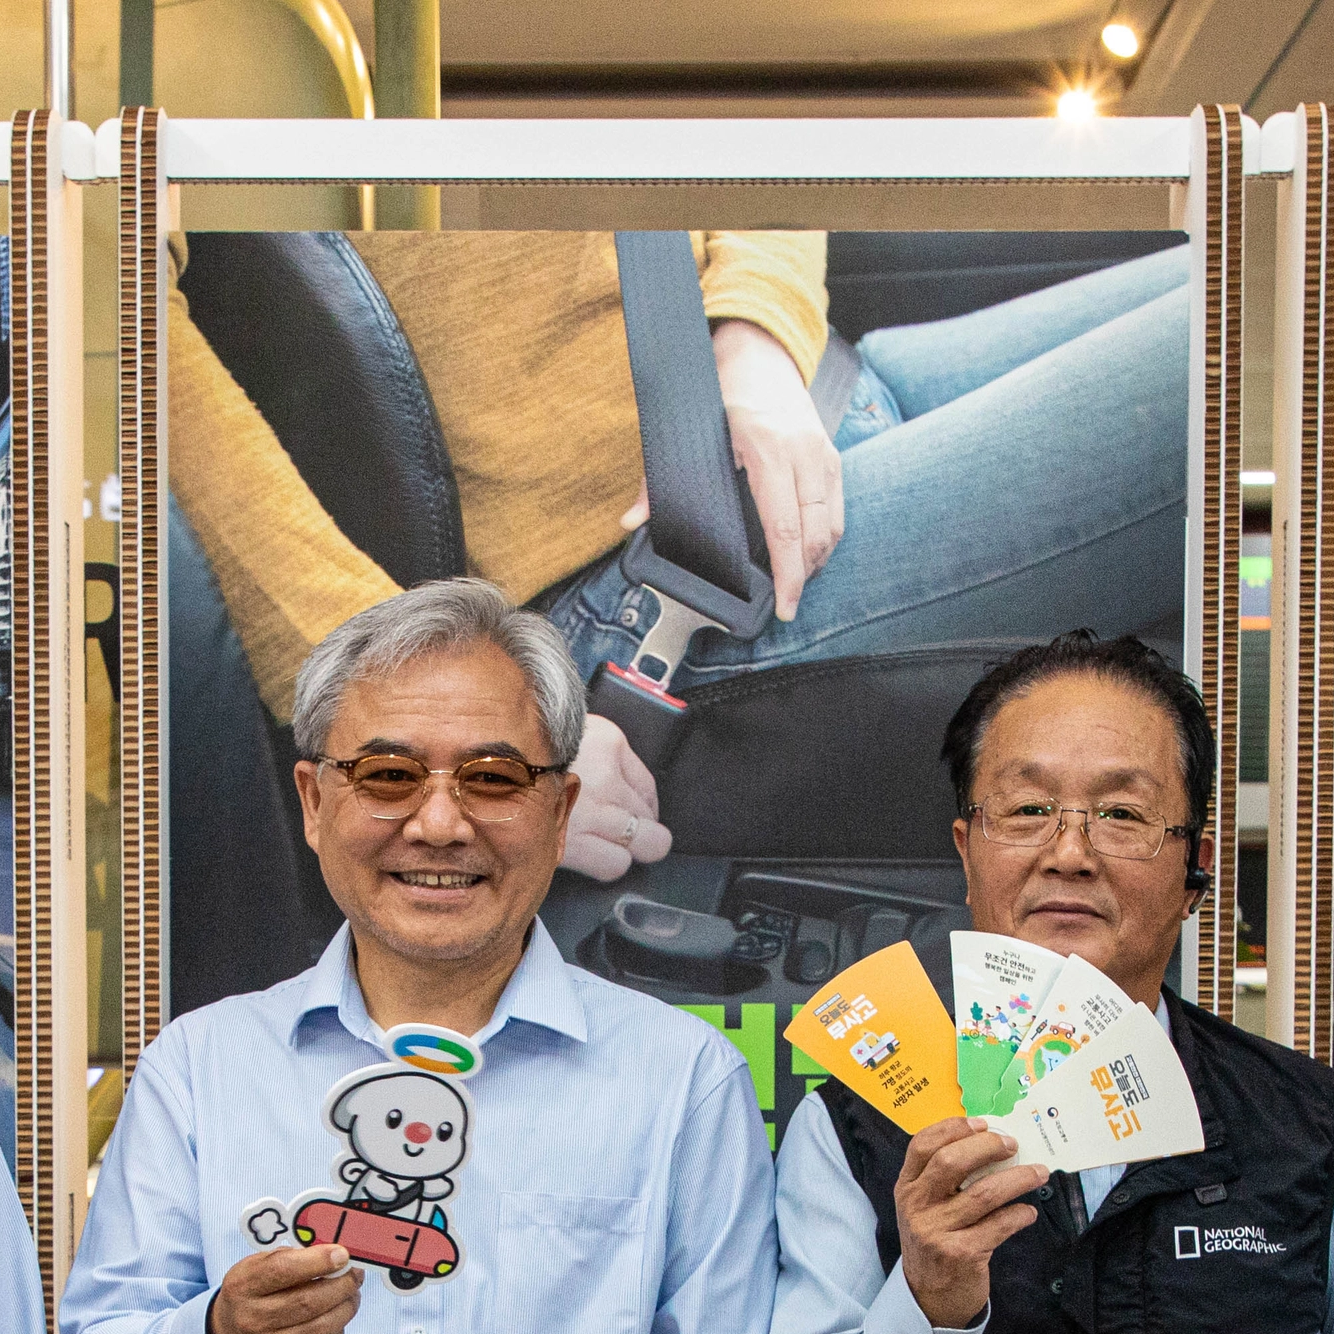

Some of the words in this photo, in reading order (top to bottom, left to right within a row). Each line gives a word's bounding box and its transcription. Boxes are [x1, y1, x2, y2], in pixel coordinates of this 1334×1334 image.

[984, 952, 1007, 965] 무조건
[1010, 960, 1036, 974] 안전하고
[1003, 950, 1020, 959] 누구나
[985, 962, 1002, 973] 행복한
[1003, 968, 1020, 979] 일상을
[1022, 974, 1034, 982] 위한
[999, 976, 1017, 985] 캠페인
[1095, 994, 1109, 1009] 무사히
[1109, 998, 1123, 1013] 어디든
[819, 1000, 851, 1026] 오늘도
[826, 994, 877, 1040] 무사고
[1086, 998, 1111, 1025] 교통사고
[879, 1068, 891, 1079] 하루
[890, 1061, 902, 1072] 평균
[882, 1078, 895, 1090] 7명
[895, 1066, 912, 1082] 정도의
[893, 1089, 915, 1108] 사망자
[915, 1078, 930, 1092] 발생
[894, 1077, 915, 1095] 교통사고
[1109, 1060, 1139, 1107] 오늘도
[1090, 1066, 1142, 1141] 무사고
[1031, 1109, 1041, 1123] TS
[1204, 1226, 1267, 1241] NATIONAL
[1204, 1238, 1287, 1253] GEOGRAPHIC
